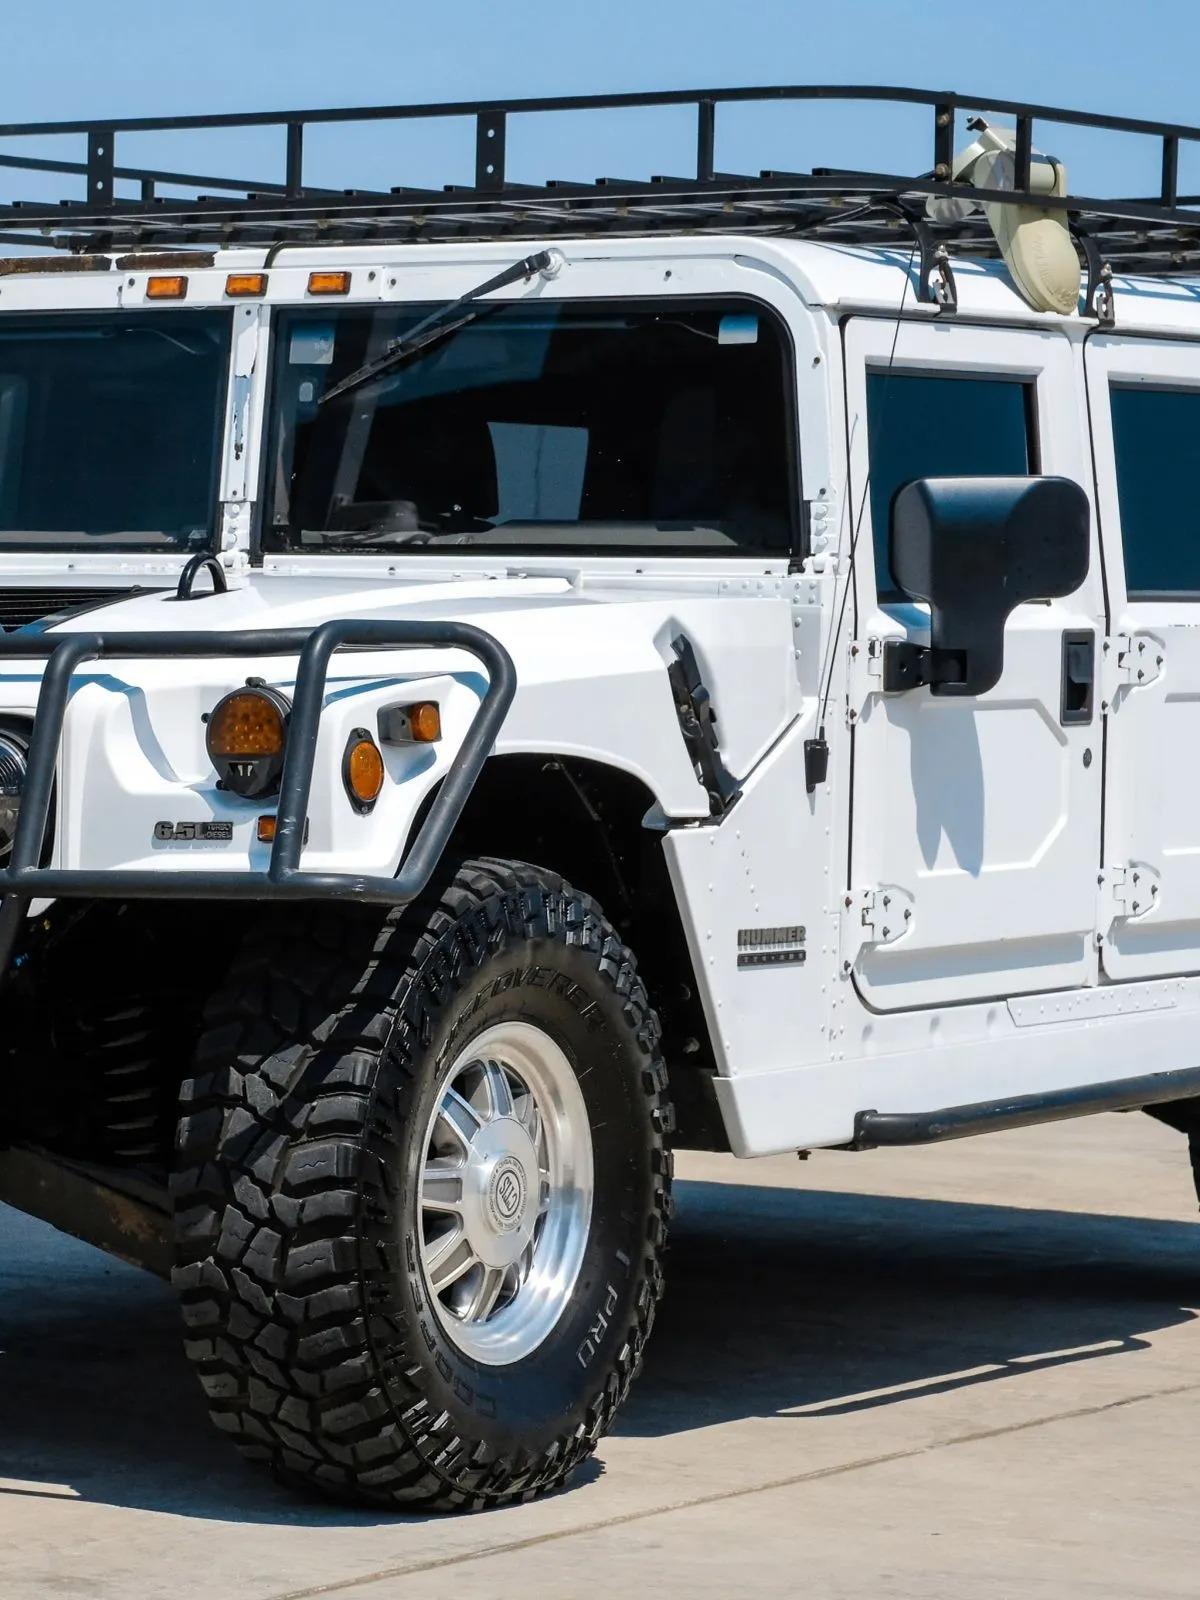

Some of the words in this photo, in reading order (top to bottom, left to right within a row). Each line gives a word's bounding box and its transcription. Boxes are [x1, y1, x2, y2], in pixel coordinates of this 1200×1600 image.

[154, 821, 207, 840] 6.5L
[737, 925, 806, 946] HUMMER
[576, 1281, 619, 1369] PRO
